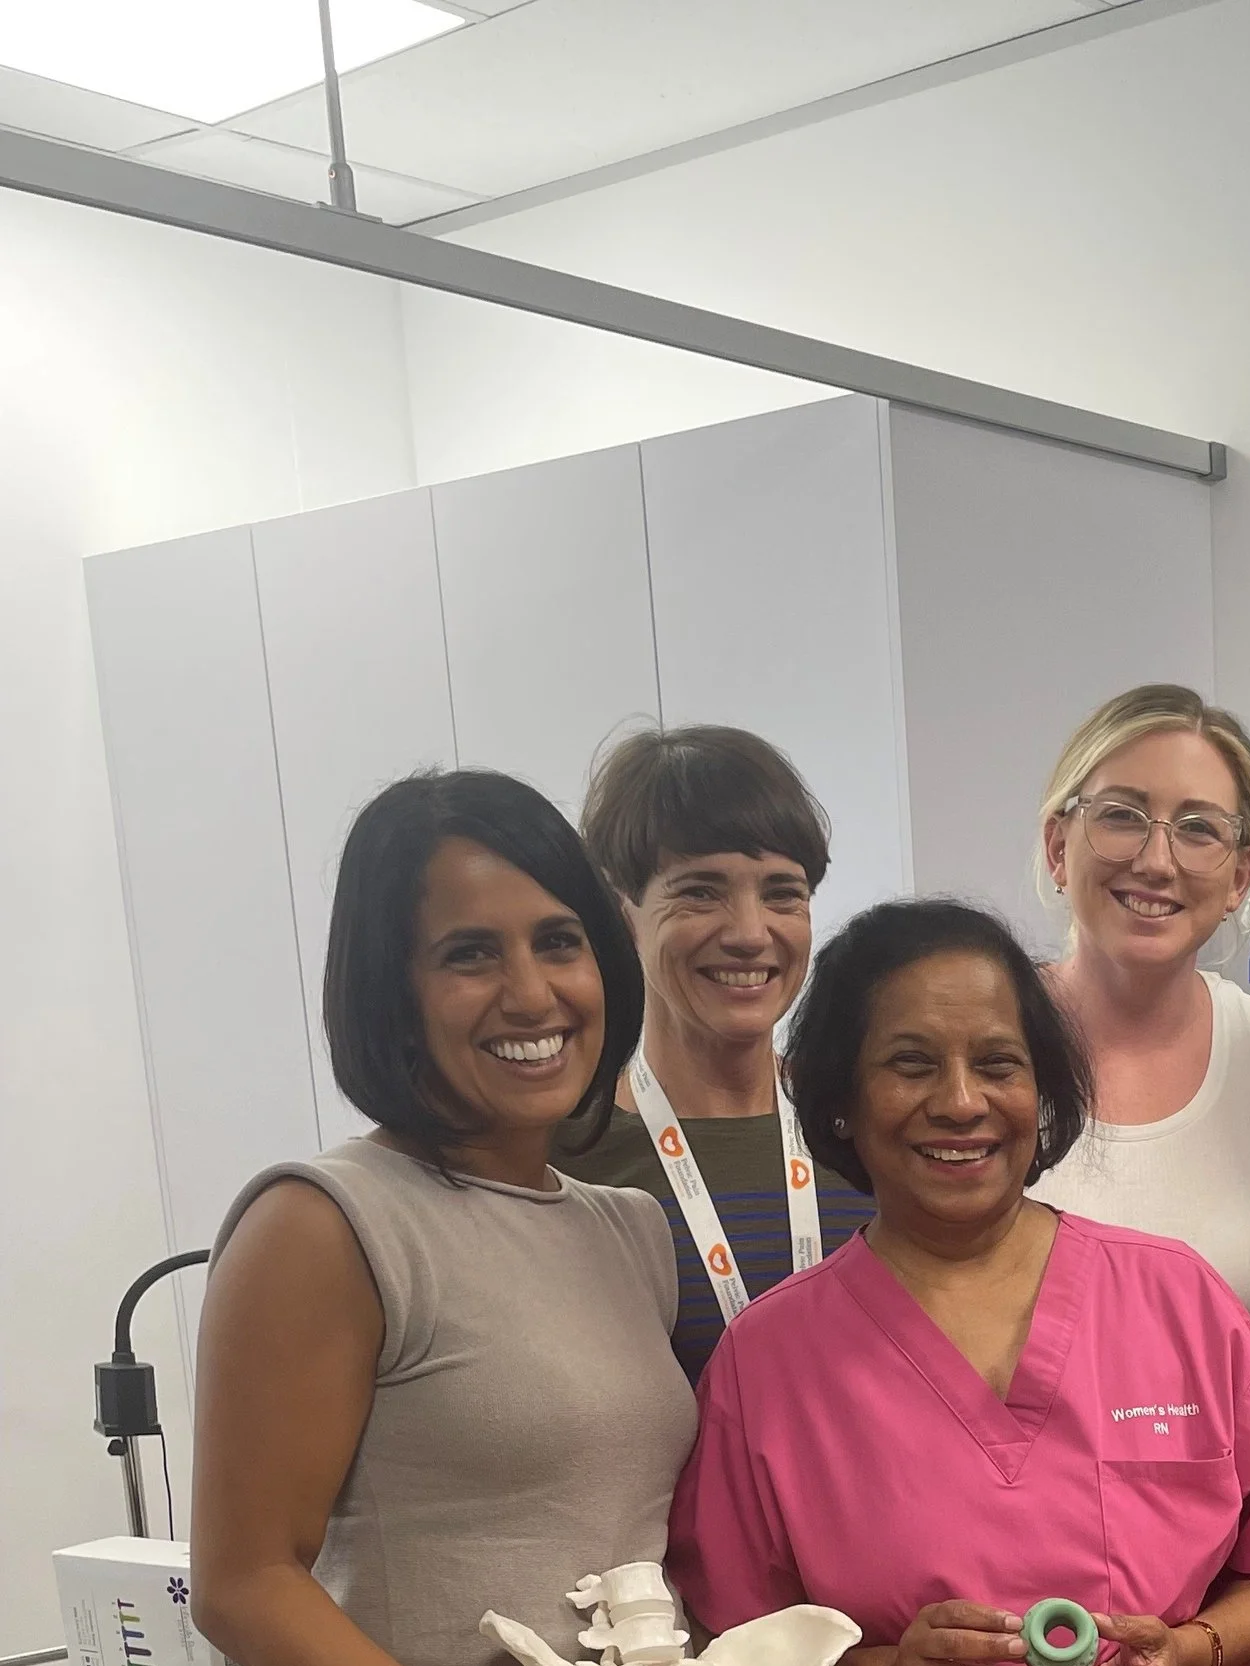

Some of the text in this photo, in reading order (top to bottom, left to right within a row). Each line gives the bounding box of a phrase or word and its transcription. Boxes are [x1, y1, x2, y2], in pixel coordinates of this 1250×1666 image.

[673, 1160, 694, 1200] Foundation
[680, 1158, 701, 1196] Pelvic Pain
[729, 1277, 741, 1300] Pelvic
[1111, 1403, 1200, 1422] Women's Health
[1153, 1422, 1170, 1435] RN
